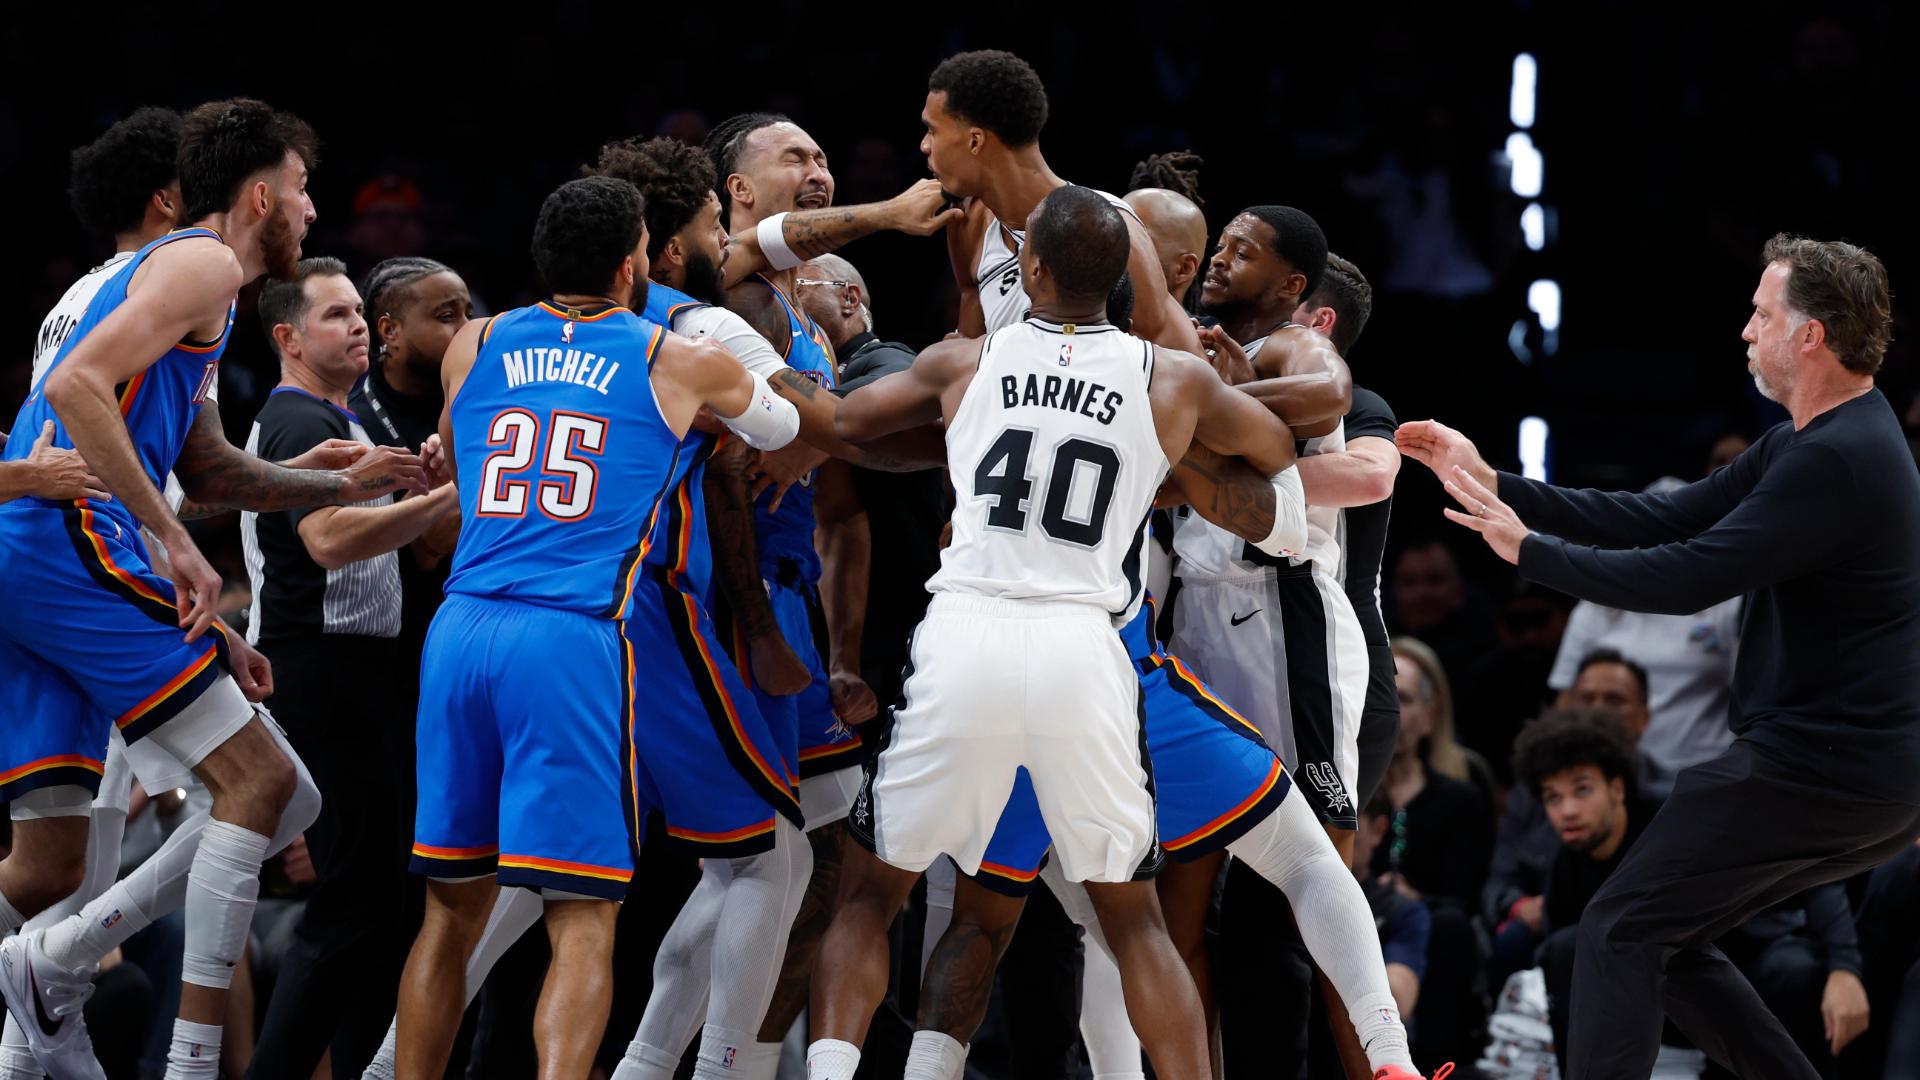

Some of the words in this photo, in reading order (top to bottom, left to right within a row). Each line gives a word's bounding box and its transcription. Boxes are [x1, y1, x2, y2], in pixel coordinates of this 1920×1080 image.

[502, 348, 620, 395] MITCHELL
[1002, 374, 1123, 426] BARNES
[477, 407, 609, 522] 25
[972, 424, 1123, 551] 40
